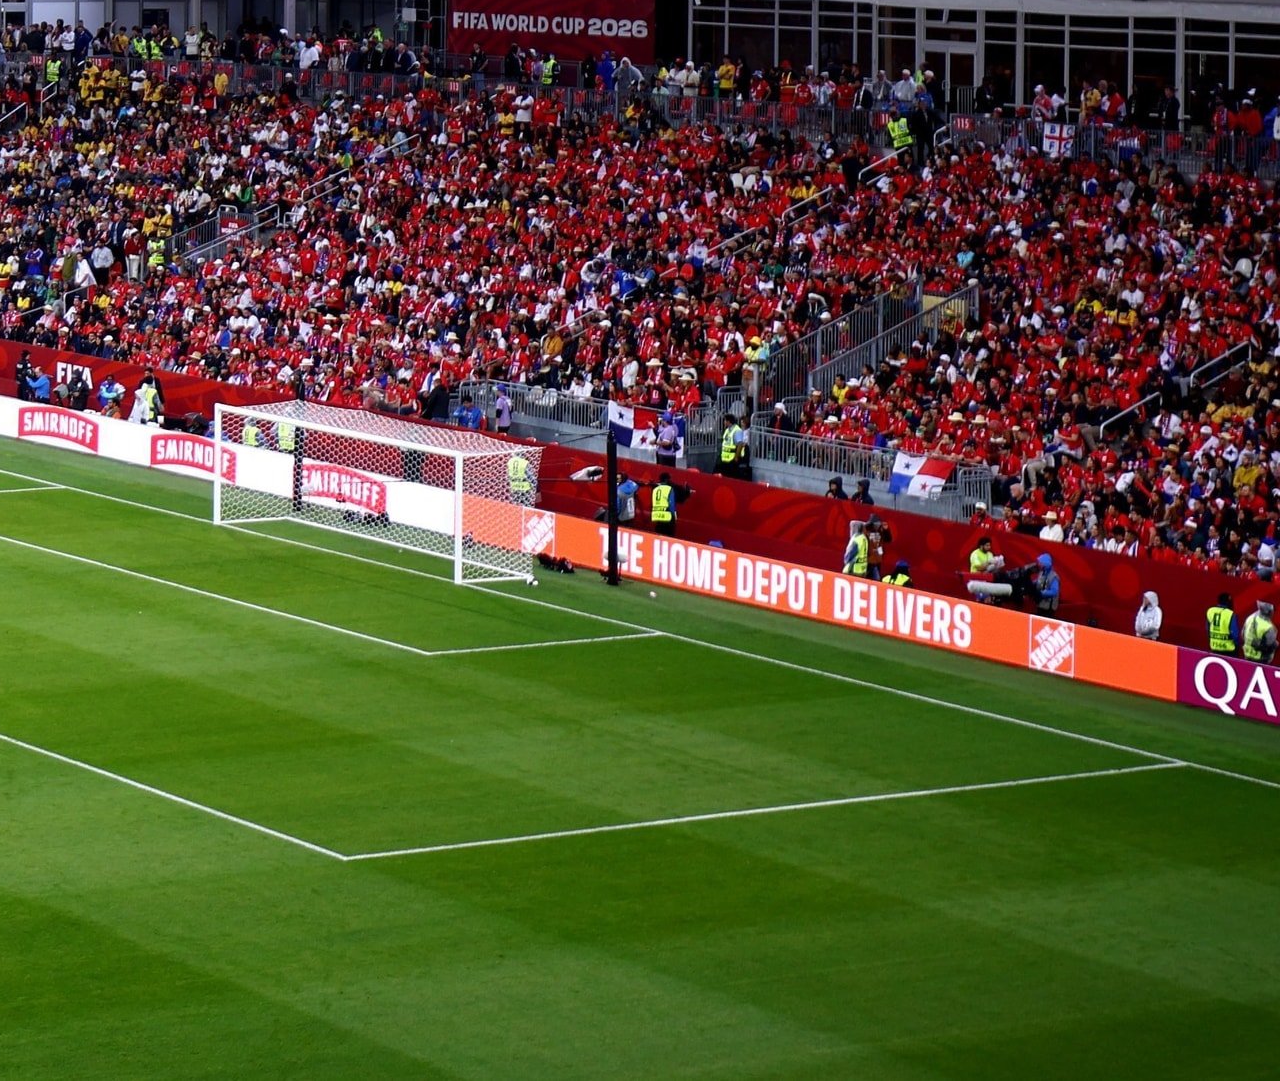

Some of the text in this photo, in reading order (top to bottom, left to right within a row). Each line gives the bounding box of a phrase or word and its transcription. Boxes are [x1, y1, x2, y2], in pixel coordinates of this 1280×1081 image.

[452, 11, 649, 39] FIFA WORLD CUP 2026
[957, 118, 969, 129] 115
[23, 410, 95, 445] SMIRNOFF
[156, 439, 231, 475] SMIRNOF
[652, 539, 727, 594] HOME
[744, 558, 824, 610] DEPOT
[833, 573, 972, 649] DELIVERS
[1194, 656, 1280, 716] QA
